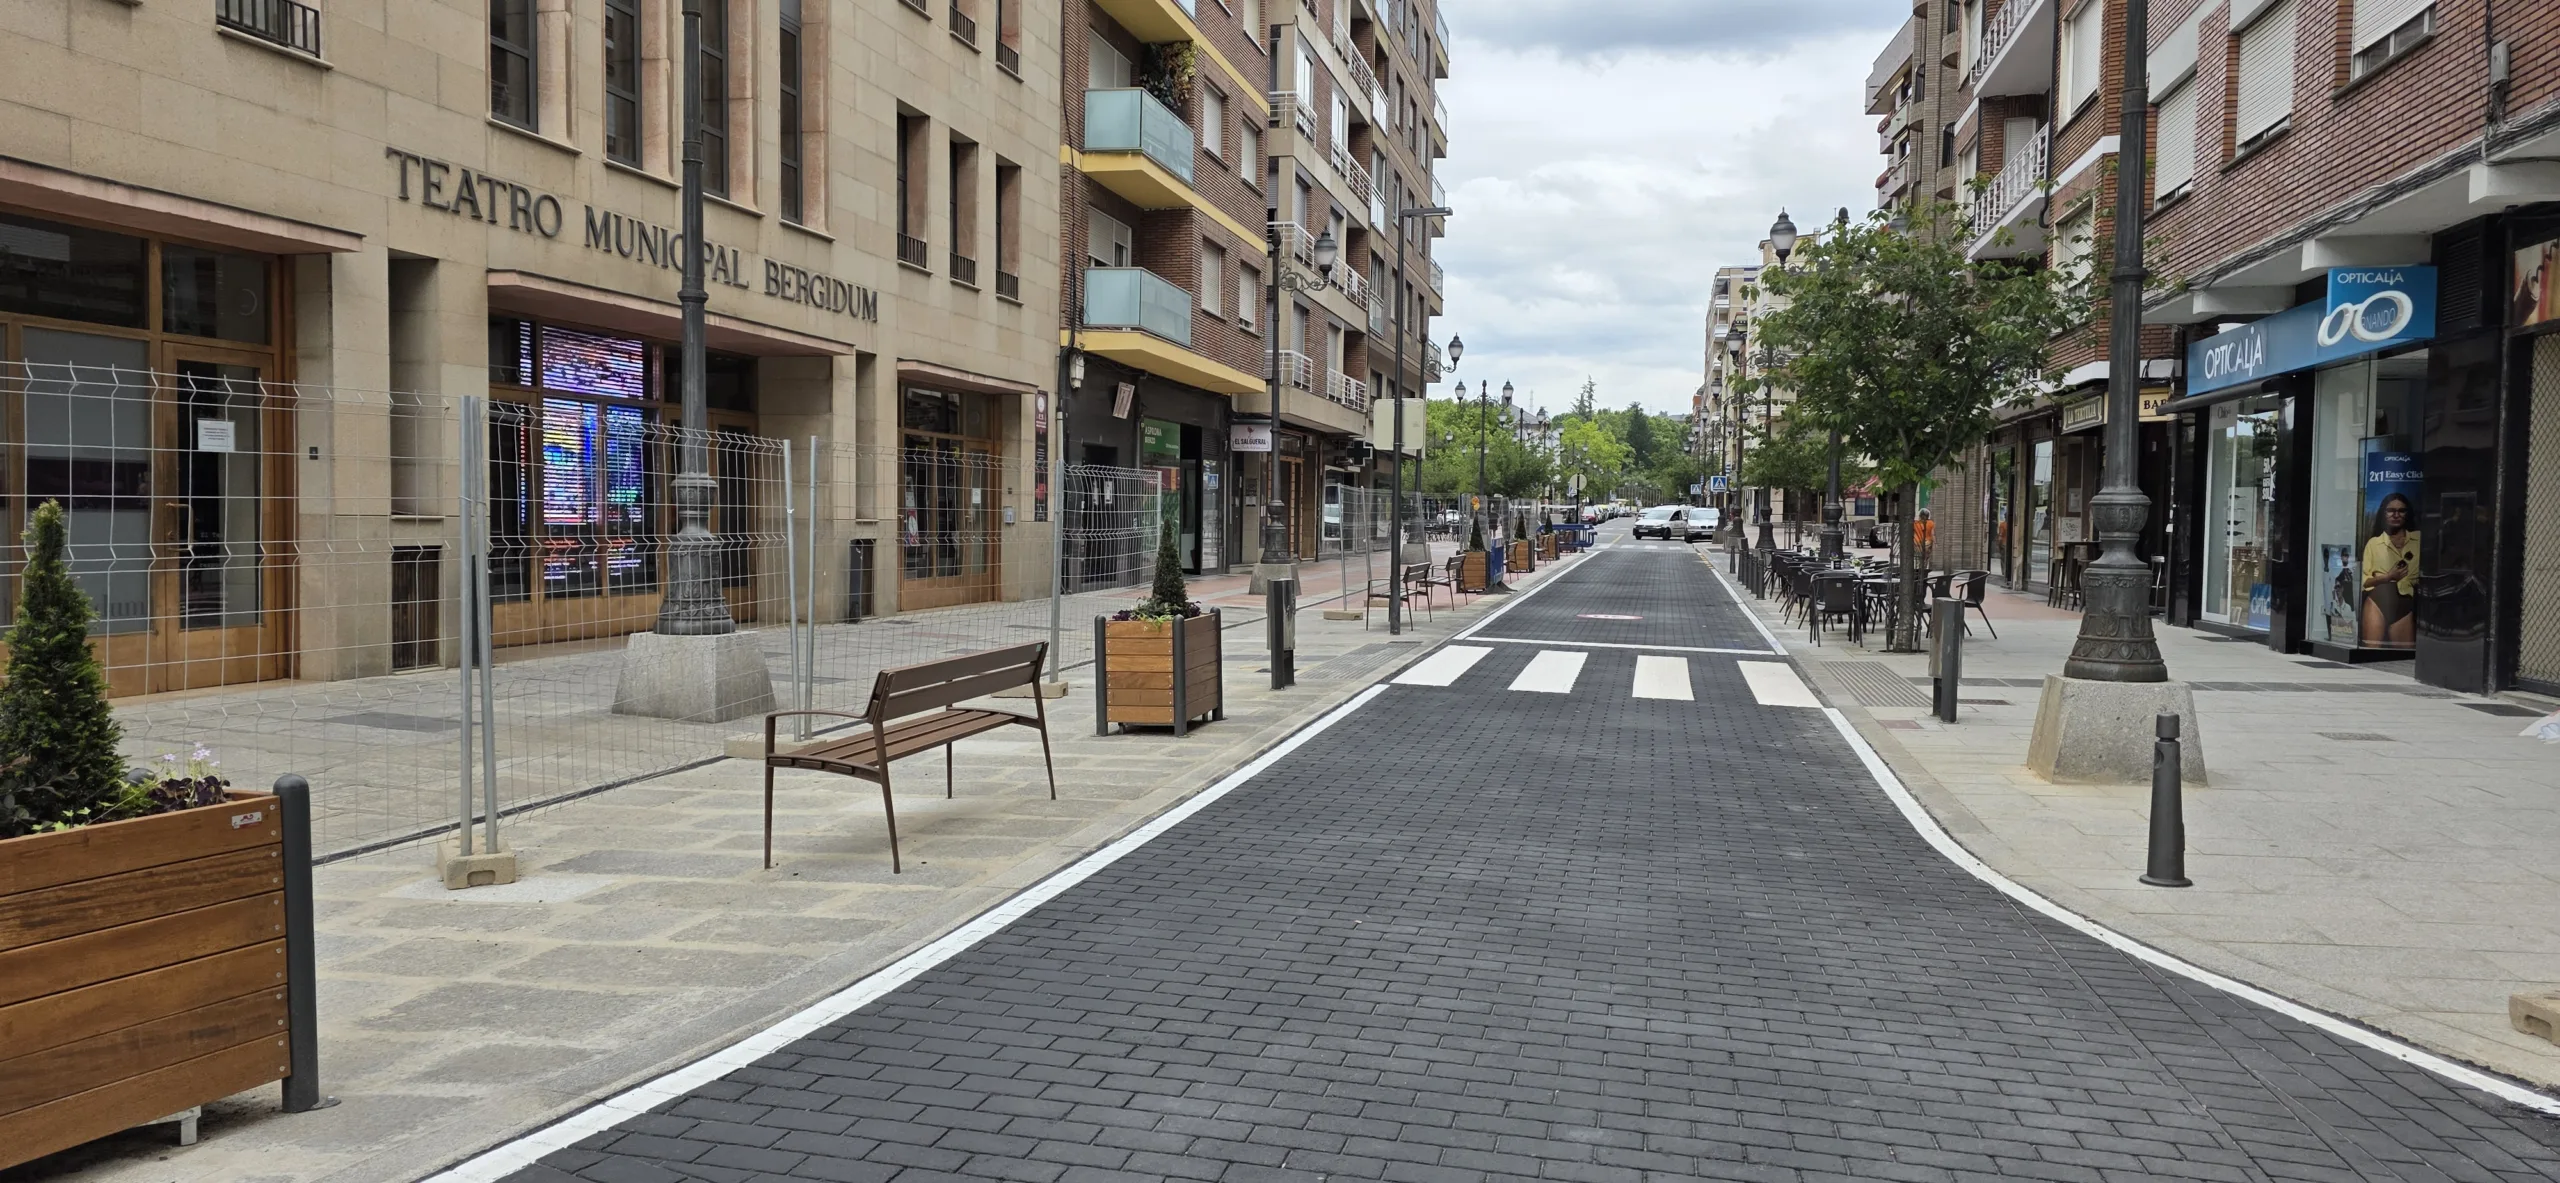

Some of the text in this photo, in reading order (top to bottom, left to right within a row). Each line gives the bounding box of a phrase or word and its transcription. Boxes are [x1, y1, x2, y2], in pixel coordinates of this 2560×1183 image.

[386, 146, 879, 323] TEATRO MUNICPAL BERGIDUM
[2385, 470, 2405, 480] Easy
